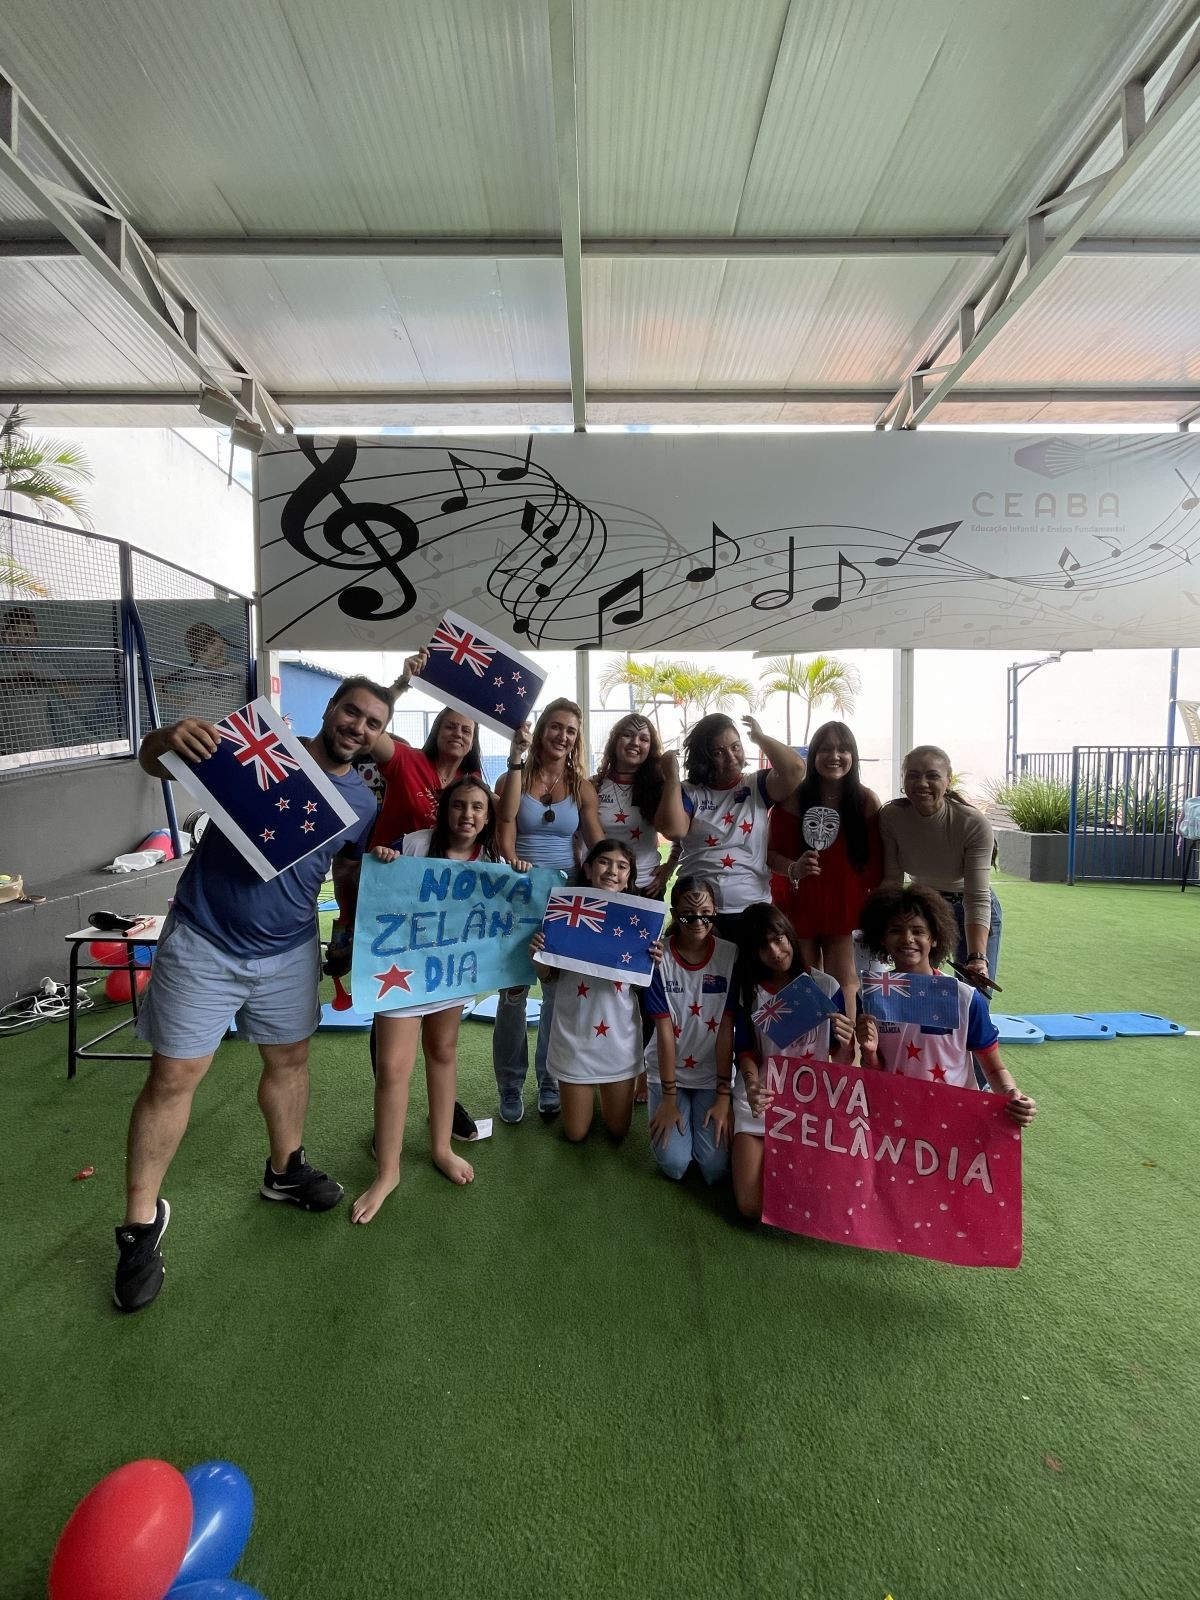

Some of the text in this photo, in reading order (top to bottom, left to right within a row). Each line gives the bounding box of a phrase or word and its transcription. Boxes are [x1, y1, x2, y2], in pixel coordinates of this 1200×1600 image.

[971, 491, 1120, 518] CEABA
[419, 867, 534, 905] NOVA
[424, 950, 478, 994] DIA
[766, 1057, 869, 1118] NOVA
[768, 1106, 993, 1194] ZELÂNDIA
